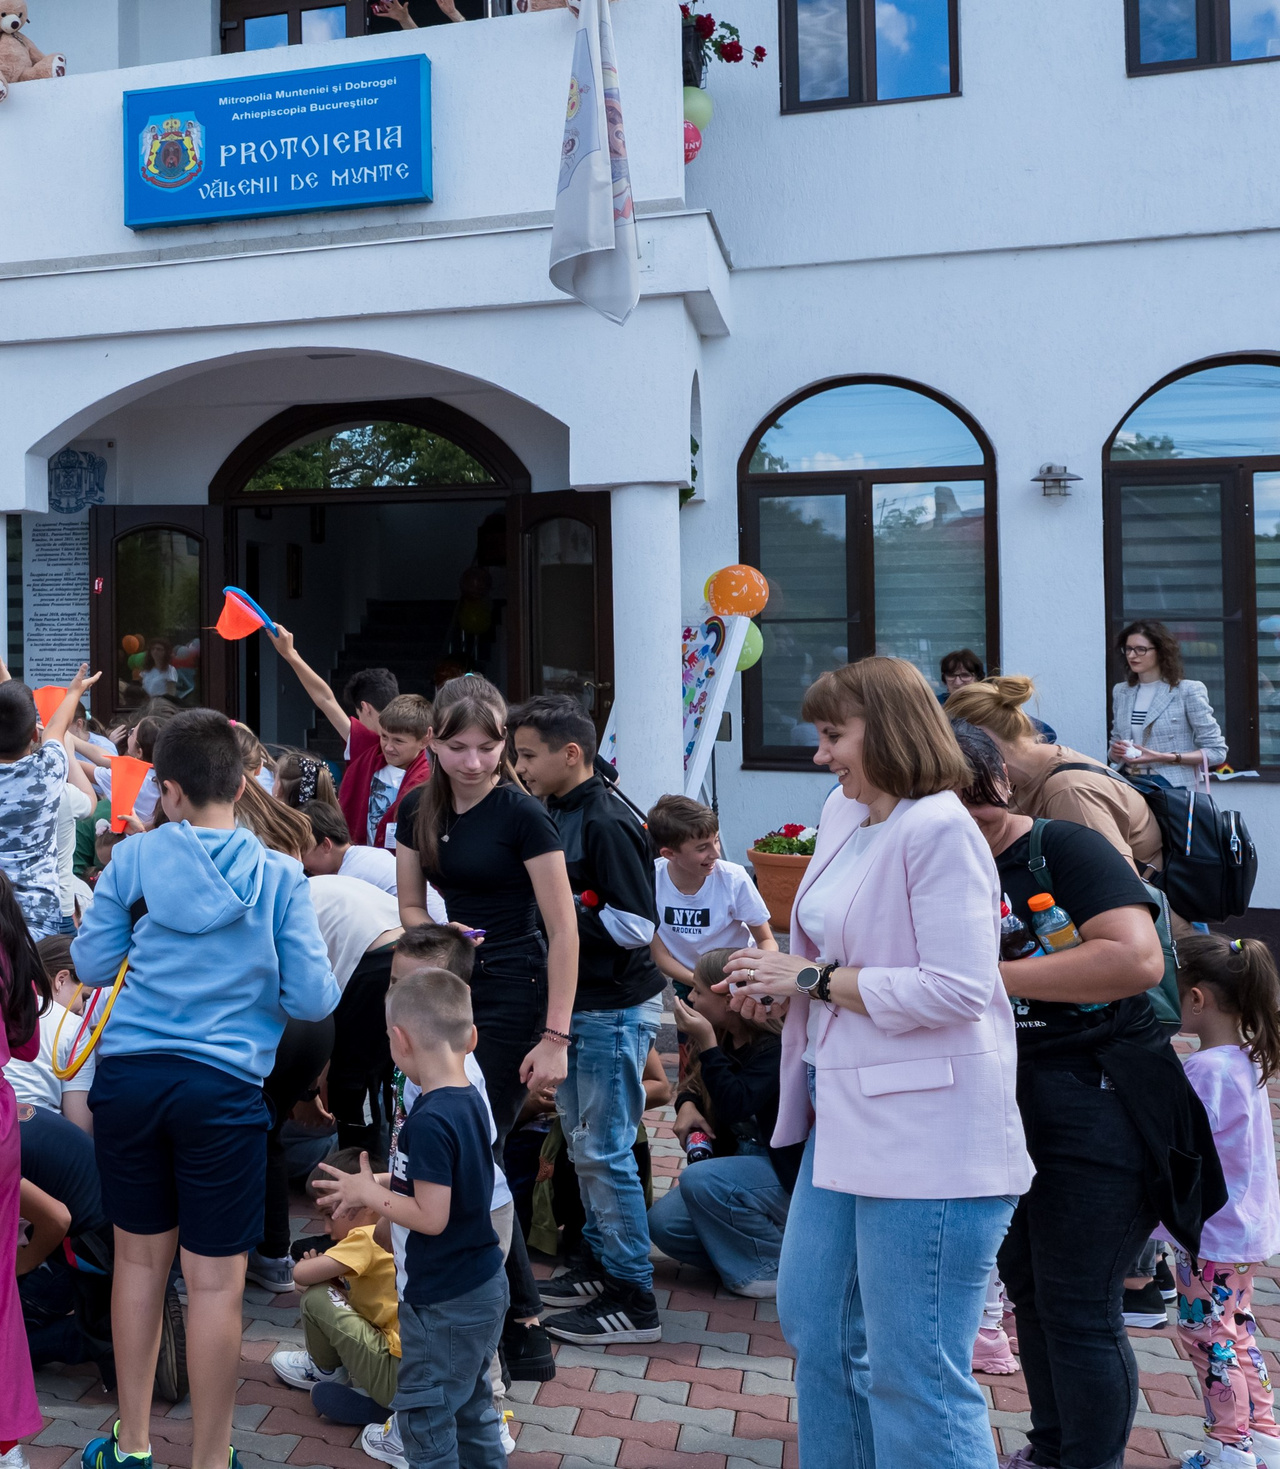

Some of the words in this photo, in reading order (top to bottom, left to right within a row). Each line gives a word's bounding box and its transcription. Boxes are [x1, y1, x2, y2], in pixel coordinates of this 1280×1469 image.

[219, 92, 272, 106] Mitropolia
[276, 85, 328, 99] Munteniei
[345, 76, 397, 91] Dobrogei
[232, 105, 306, 121] Arhiepiscopia
[310, 97, 379, 112] Bucureştilor
[220, 126, 402, 166] PROTOIERIA
[198, 176, 278, 199] VĂLENII
[290, 172, 318, 190] DE
[332, 162, 410, 186] MUNTE
[673, 909, 702, 925] NYC
